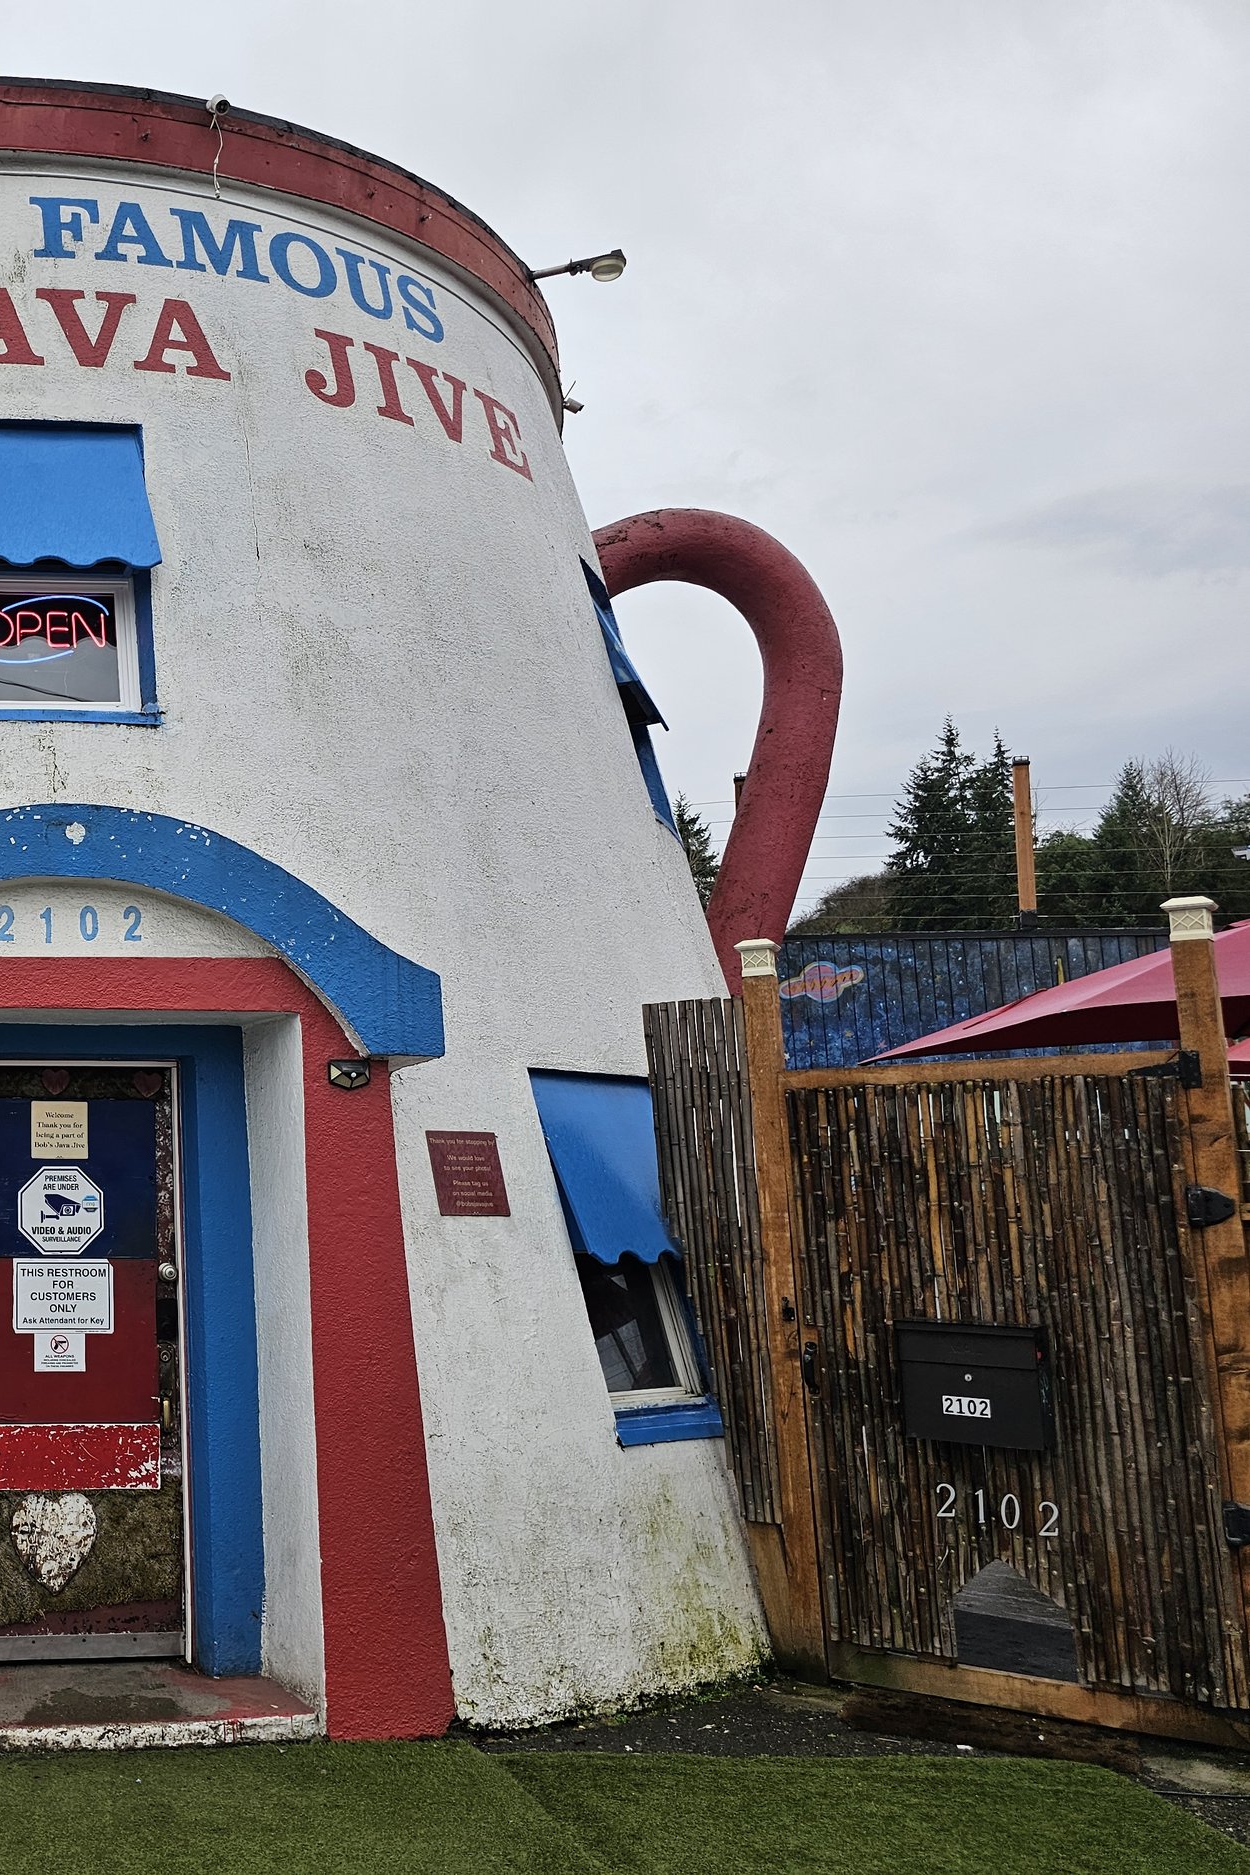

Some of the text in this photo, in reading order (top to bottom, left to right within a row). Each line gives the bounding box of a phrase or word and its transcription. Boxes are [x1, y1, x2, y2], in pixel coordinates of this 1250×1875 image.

[29, 196, 445, 343] FAMOUS
[305, 328, 533, 482] JIVE
[32, 1227, 91, 1235] VIDEO & AUDIO
[21, 1269, 106, 1277] THIS RESTROOM
[53, 1281, 74, 1289] FOR
[30, 1292, 96, 1301] CUSTOMERS
[50, 1304, 77, 1313] ONLY
[90, 1317, 104, 1325] Key
[944, 1397, 989, 1416] 2102
[936, 1484, 1059, 1536] 2102
